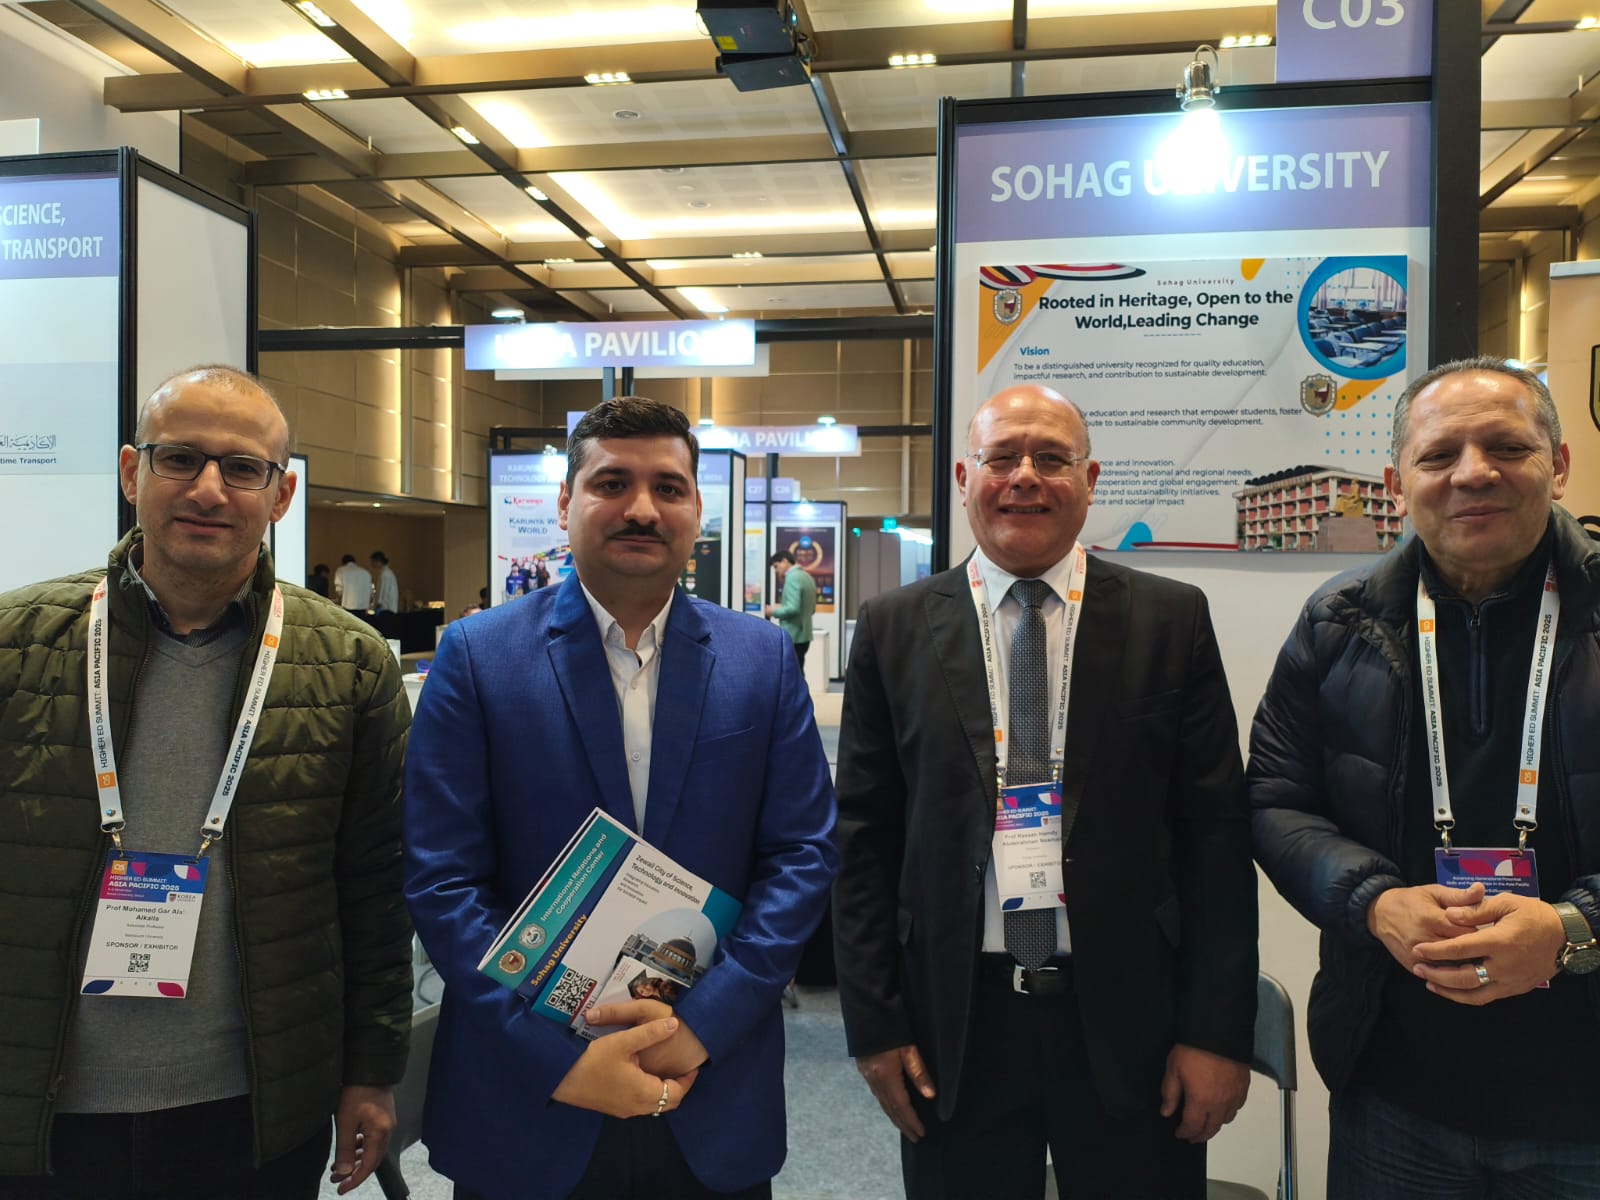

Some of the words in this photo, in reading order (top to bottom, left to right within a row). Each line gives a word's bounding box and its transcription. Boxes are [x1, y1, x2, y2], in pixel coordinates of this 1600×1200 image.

[1302, 0, 1405, 30] C03
[990, 160, 1132, 203] SOHAG
[1143, 150, 1391, 197] UVERSITY
[0, 202, 66, 227] CIENCE,
[2, 236, 104, 261] TRANSPORT
[1157, 279, 1184, 288] Sohag
[1187, 278, 1235, 287] University
[1039, 293, 1096, 310] Rooted
[1099, 293, 1115, 308] in
[1119, 291, 1193, 311] Heritage,
[1196, 292, 1240, 309] Open
[1245, 291, 1262, 305] to
[1265, 290, 1294, 305] the
[1075, 312, 1192, 331] World,Leading
[1196, 312, 1260, 329] Change
[585, 330, 716, 357] PAVILIO
[1020, 346, 1050, 358] Vision
[1014, 362, 1023, 371] To
[1024, 362, 1034, 371] be
[1042, 361, 1095, 372] distinguished
[1096, 361, 1134, 372] university
[1135, 360, 1179, 371] recognized
[1180, 360, 1191, 369] for
[1193, 359, 1221, 369] quality
[1222, 358, 1265, 368] education,
[1014, 371, 1051, 382] impactful
[1052, 371, 1087, 381] research,
[1089, 370, 1104, 379] and
[1105, 370, 1153, 379] contribution
[1154, 370, 1163, 378] to
[1164, 369, 1210, 378] sustainable
[1089, 408, 1128, 417] education
[1129, 408, 1145, 417] and
[1146, 408, 1181, 417] research
[1182, 408, 1199, 416] that
[1200, 409, 1239, 418] empower
[1240, 407, 1278, 417] students,
[1279, 407, 1302, 416] foster
[1104, 419, 1113, 427] to
[1114, 418, 1159, 427] sustainable
[1160, 418, 1206, 429] community
[1207, 417, 1264, 428] development.
[20, 456, 57, 467] Transport
[1115, 459, 1131, 467] and
[1131, 459, 1175, 467] innovation.
[1141, 468, 1174, 477] national
[1175, 468, 1191, 477] and
[1192, 468, 1225, 479] regional
[1225, 469, 1253, 477] needs.
[1110, 488, 1125, 496] and
[1126, 488, 1180, 498] sustainability
[1142, 478, 1157, 487] and
[1158, 478, 1184, 489] global
[1185, 479, 1240, 489] engagement.
[1108, 498, 1124, 506] and
[1125, 498, 1155, 506] societal
[1156, 498, 1185, 508] impact
[518, 526, 548, 535] WORLD
[94, 619, 103, 635] 2025
[1542, 613, 1553, 634] 2025
[93, 636, 103, 671] PACIFIC
[986, 646, 994, 663] ASIA
[1538, 635, 1549, 668] PACIFIC
[260, 650, 271, 677] HIGHER
[93, 672, 102, 689] ASIA
[257, 677, 265, 688] ED
[1535, 668, 1543, 687] ASIA
[1059, 681, 1069, 712] PACIFIC
[242, 719, 253, 738] ASIA
[1057, 712, 1065, 730] 2025
[1429, 709, 1438, 730] ASIA
[1529, 722, 1536, 734] ED
[96, 726, 105, 737] ED
[96, 738, 108, 768] HIGHER
[230, 739, 247, 774] PACIFIC
[1432, 730, 1442, 764] PACIFIC
[1527, 735, 1535, 765] HIGHER
[221, 773, 236, 796] 2025
[1435, 765, 1443, 787] 2025
[109, 874, 133, 882] HIGHER
[540, 878, 574, 922] International
[571, 848, 598, 880] Relations
[595, 834, 607, 850] and
[654, 865, 666, 876] City
[666, 869, 674, 878] of
[556, 873, 589, 915] Cooperation
[586, 851, 605, 873] Center
[631, 862, 663, 885] Technology
[662, 881, 674, 891] and
[673, 887, 701, 905] Innovation
[122, 905, 156, 914] Mohamed
[531, 959, 557, 987] Sohag
[552, 914, 588, 960] University
